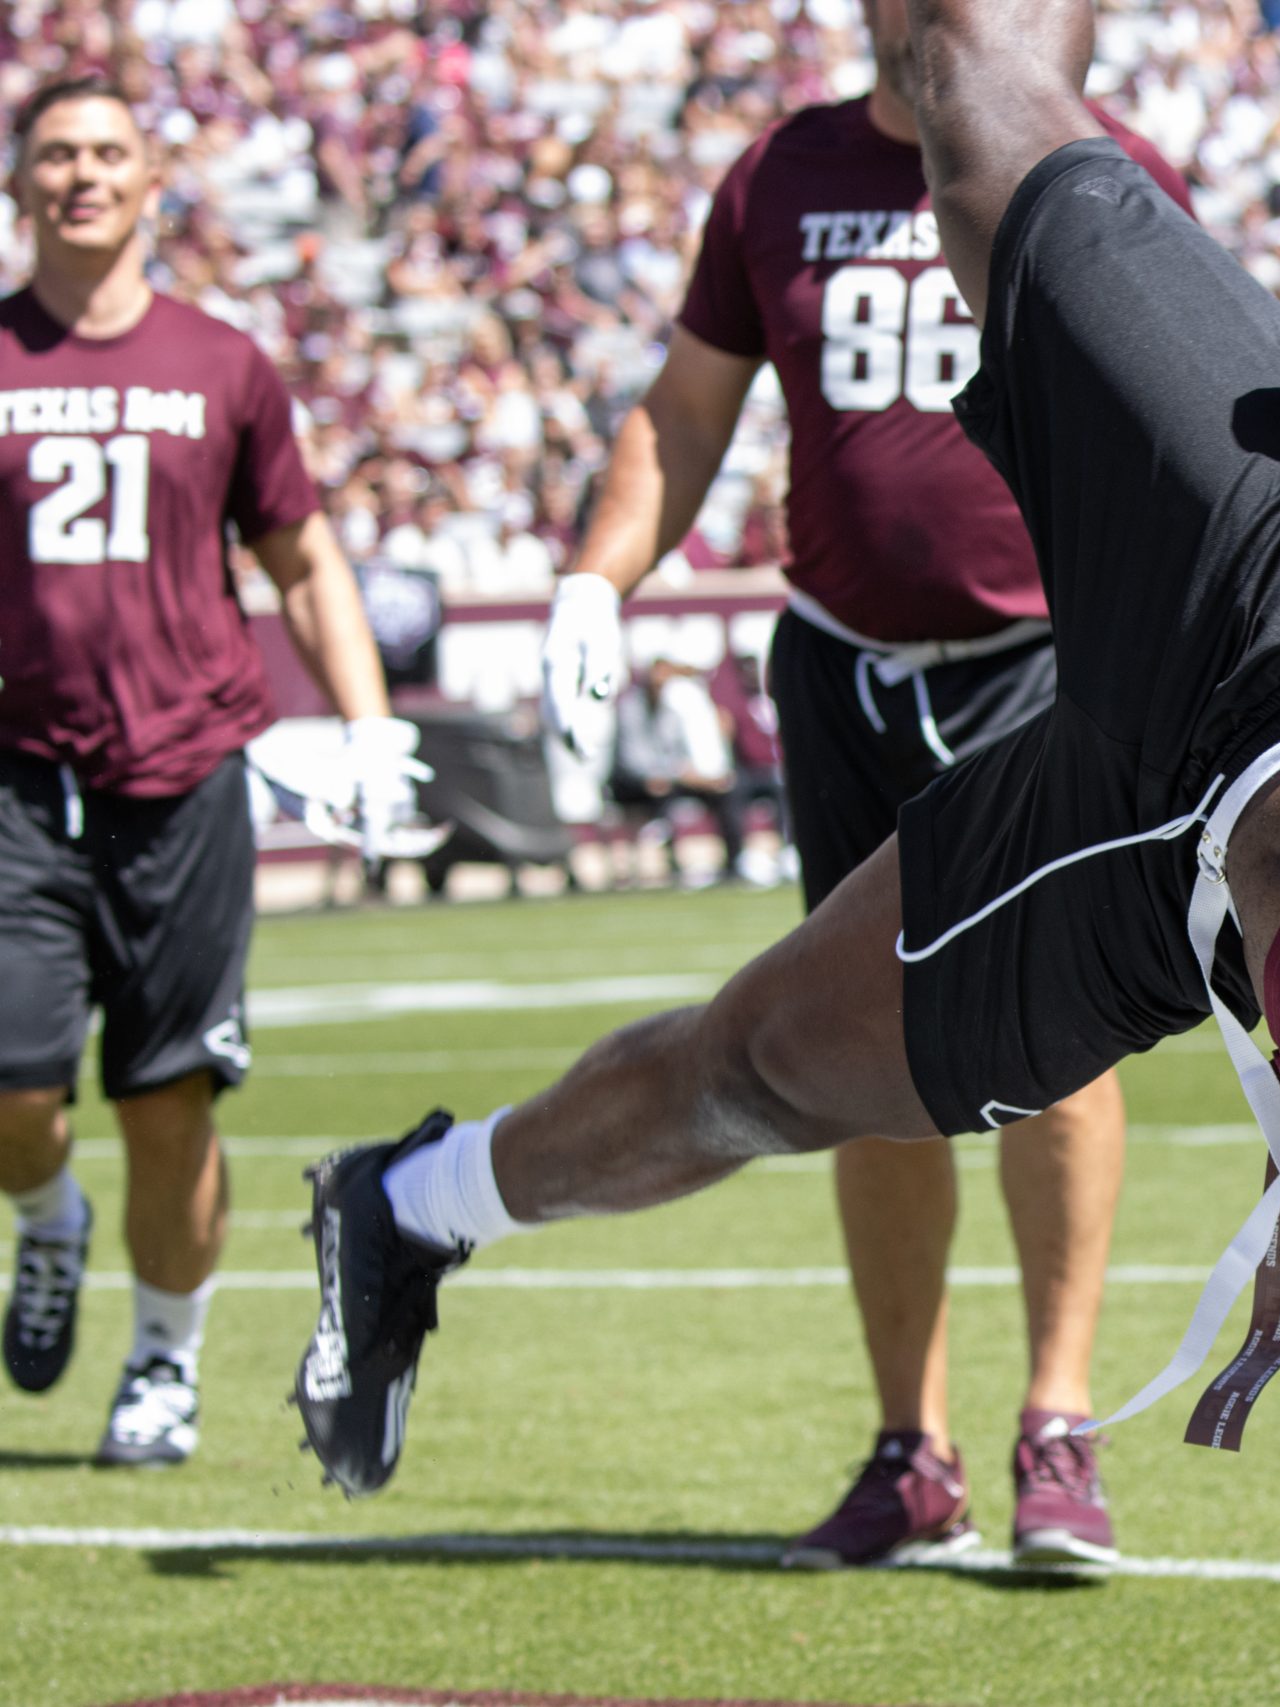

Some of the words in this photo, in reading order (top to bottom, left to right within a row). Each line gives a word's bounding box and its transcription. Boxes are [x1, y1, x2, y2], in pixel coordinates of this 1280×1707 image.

[799, 209, 941, 261] TEXAS
[820, 264, 981, 412] 86
[28, 434, 150, 564] 21
[1243, 1328, 1263, 1357] AGGIE
[1220, 1391, 1240, 1420] AGGIE
